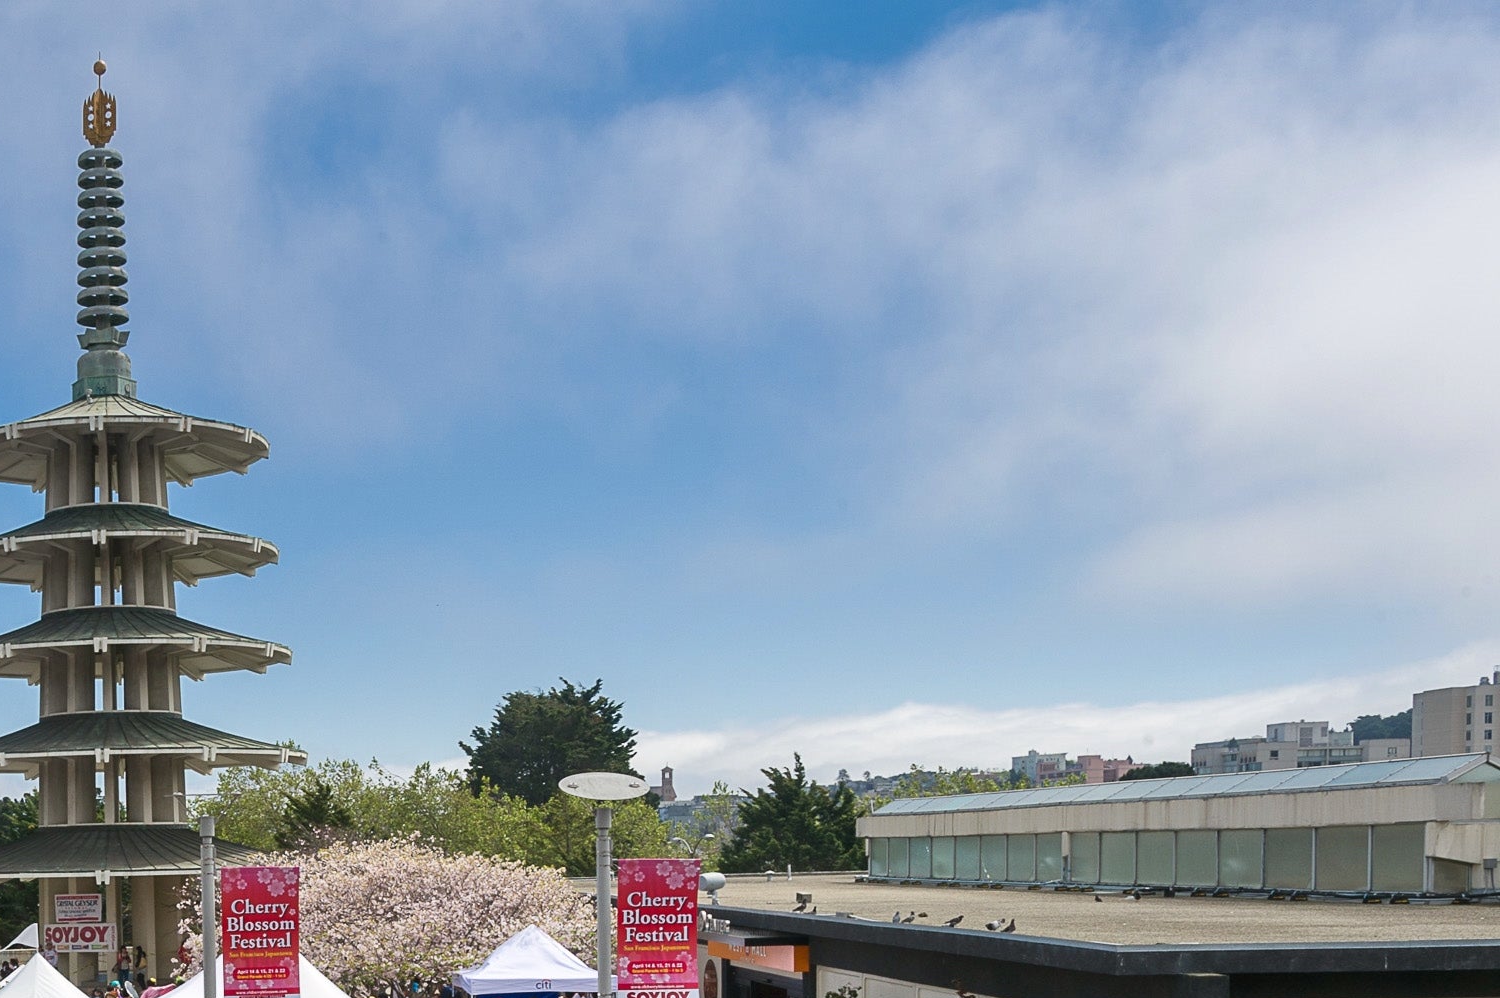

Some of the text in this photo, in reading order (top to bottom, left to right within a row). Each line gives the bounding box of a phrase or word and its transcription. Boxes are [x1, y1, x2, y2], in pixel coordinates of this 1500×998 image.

[231, 899, 289, 917] Cherry
[627, 891, 688, 910] Cherry
[227, 917, 295, 932] Blossom
[622, 909, 693, 926] Blossom
[45, 926, 109, 943] SOYJOY
[230, 932, 291, 949] Festival
[625, 926, 689, 943] Festival
[535, 980, 552, 990] citi
